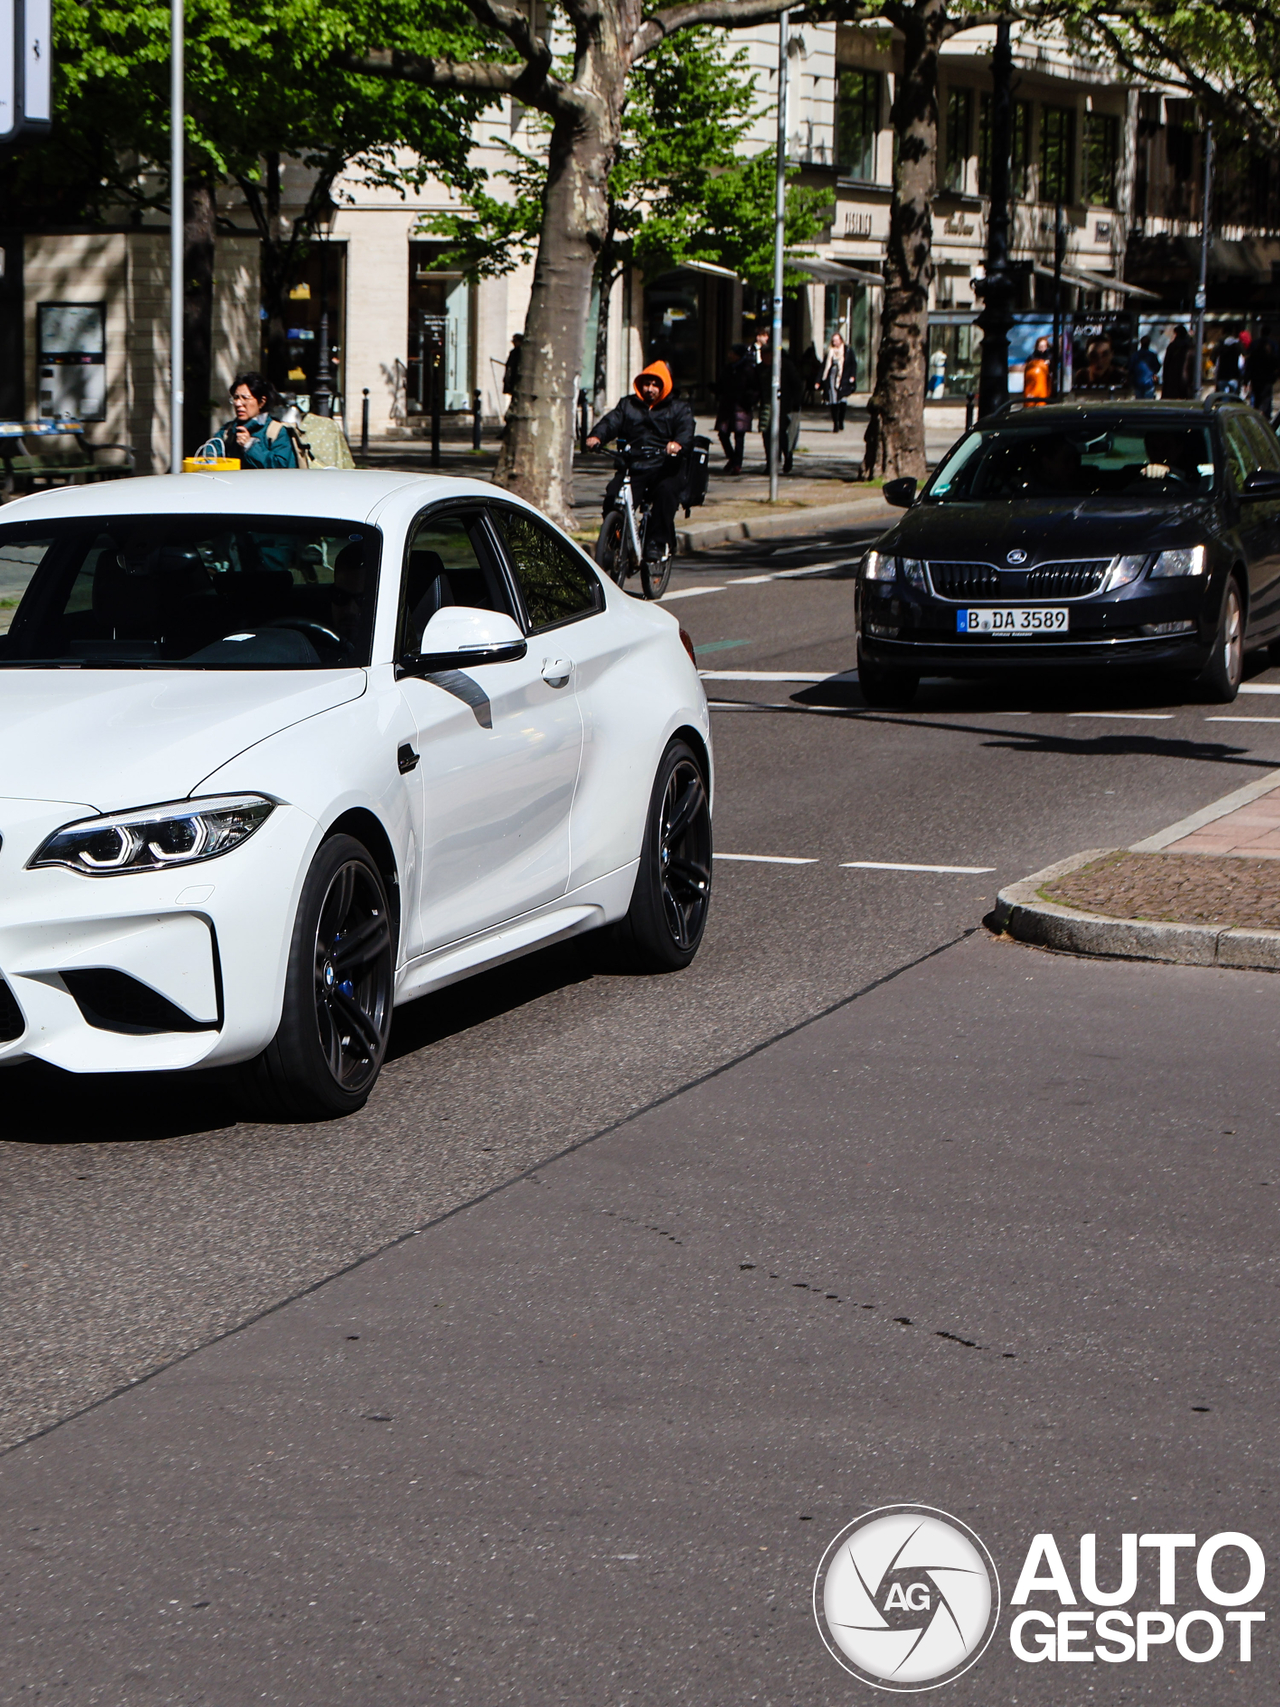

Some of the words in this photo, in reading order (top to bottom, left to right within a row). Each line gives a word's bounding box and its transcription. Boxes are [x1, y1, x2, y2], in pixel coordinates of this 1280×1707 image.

[968, 611, 980, 629] B
[992, 611, 1015, 629] DA
[1020, 611, 1066, 629] 3589
